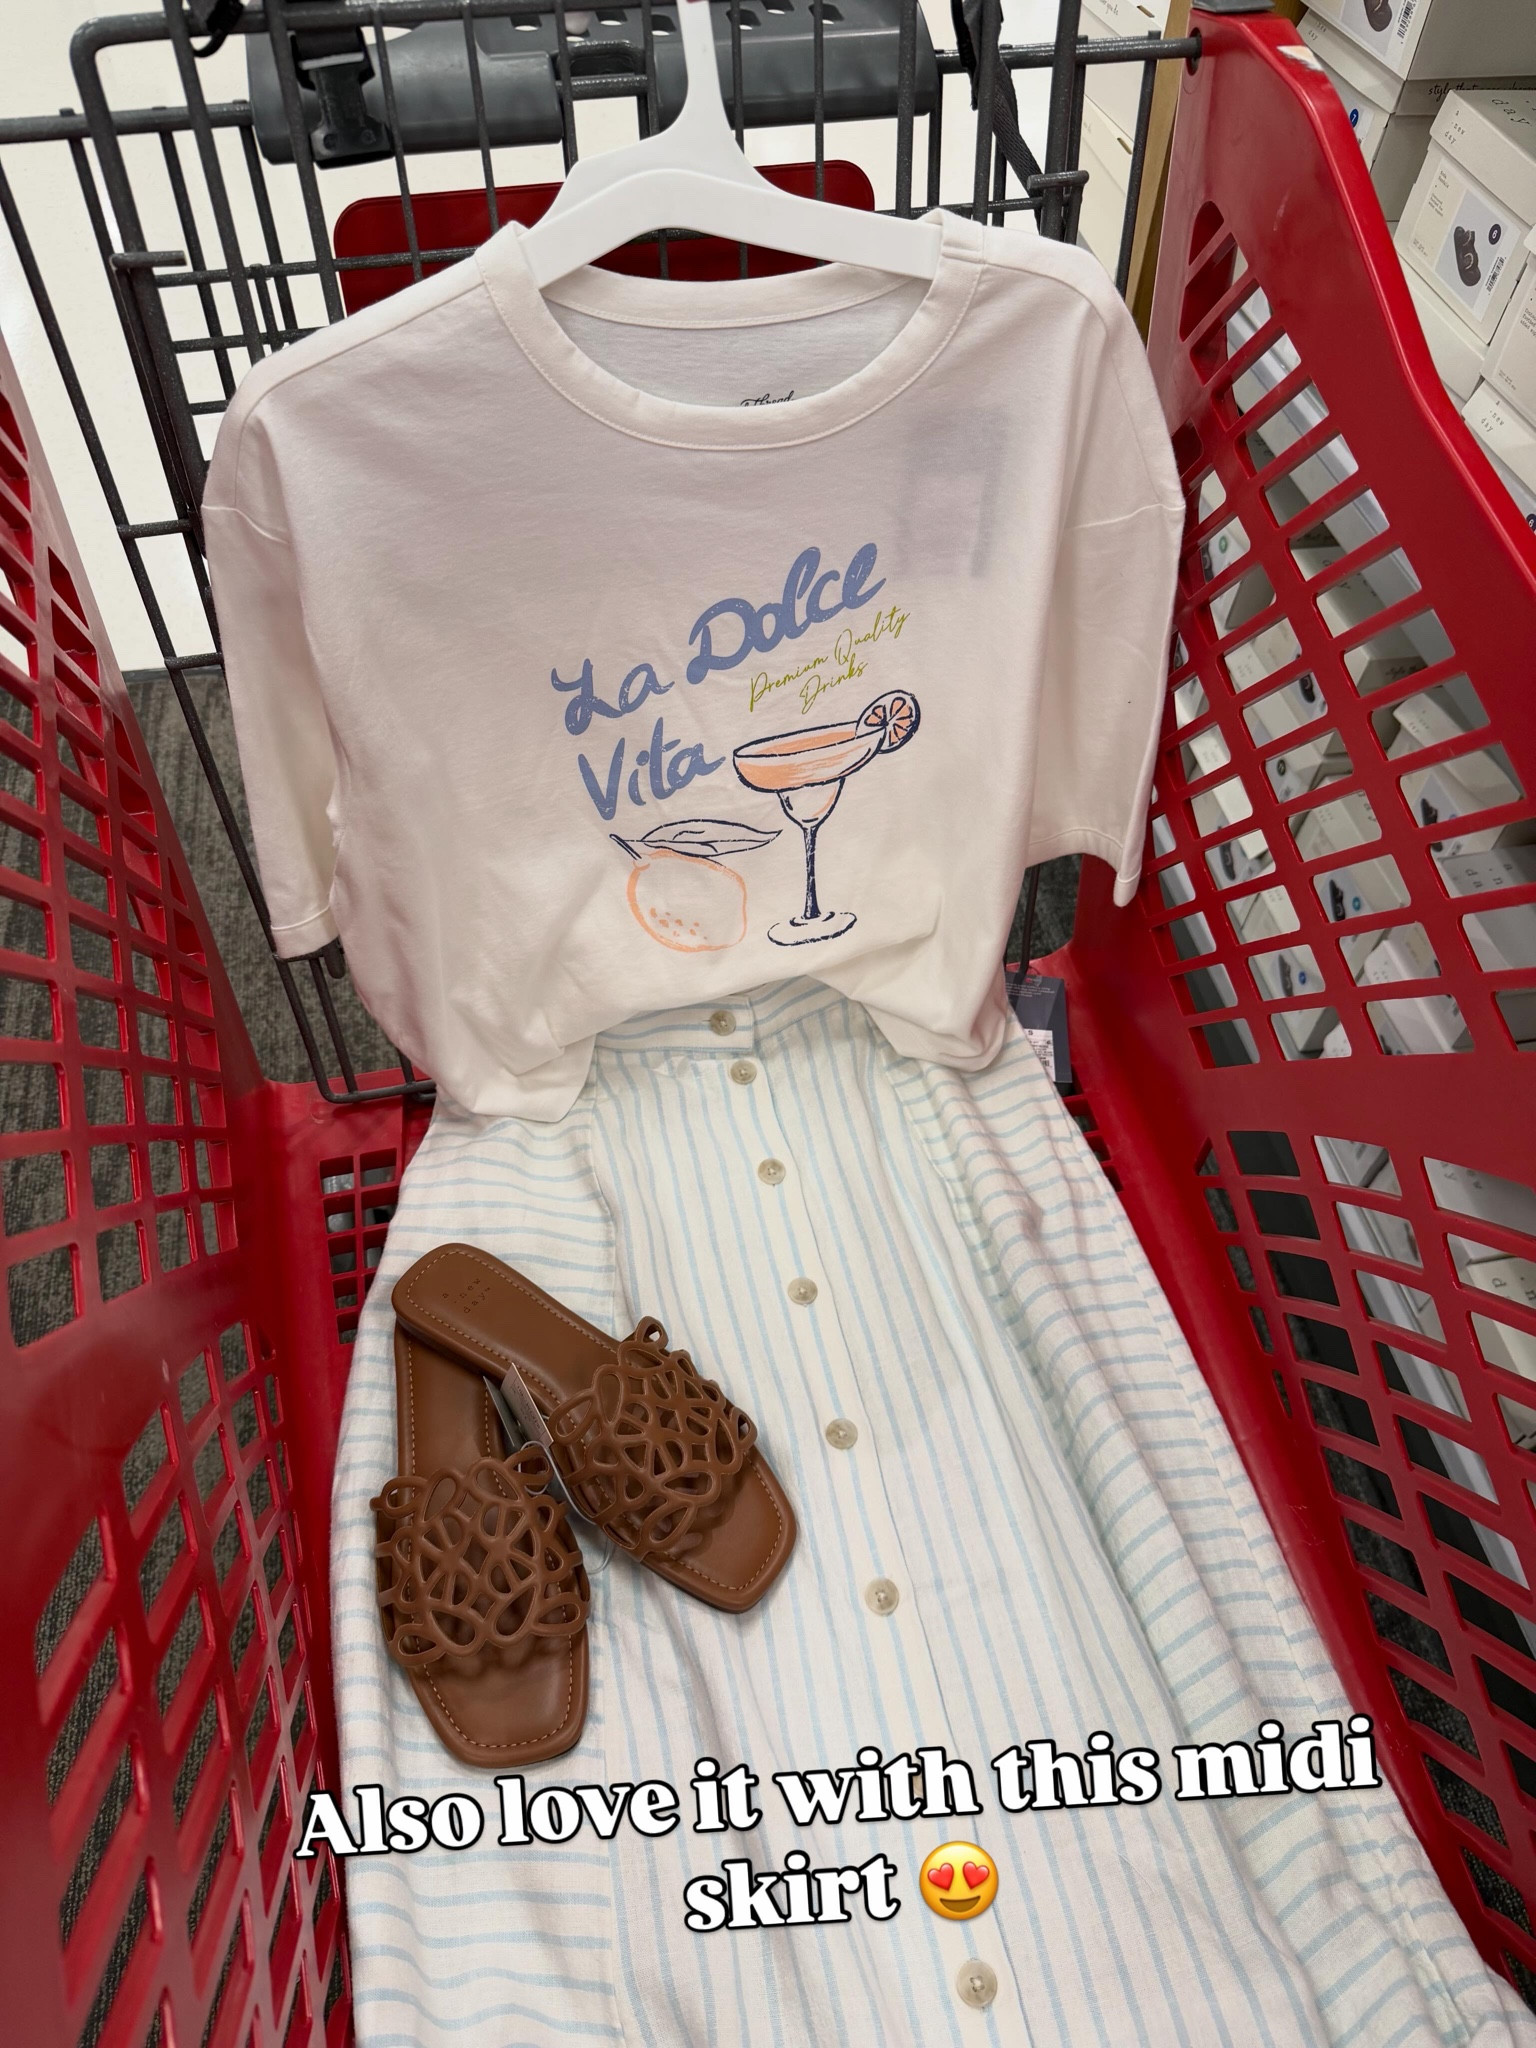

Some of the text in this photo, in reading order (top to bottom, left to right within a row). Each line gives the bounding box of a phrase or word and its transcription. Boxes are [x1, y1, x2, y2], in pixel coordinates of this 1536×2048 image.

[551, 542, 887, 736] La Dolce
[750, 605, 911, 713] Premium Quality
[799, 652, 869, 715] Drinks
[577, 716, 727, 821] Vita
